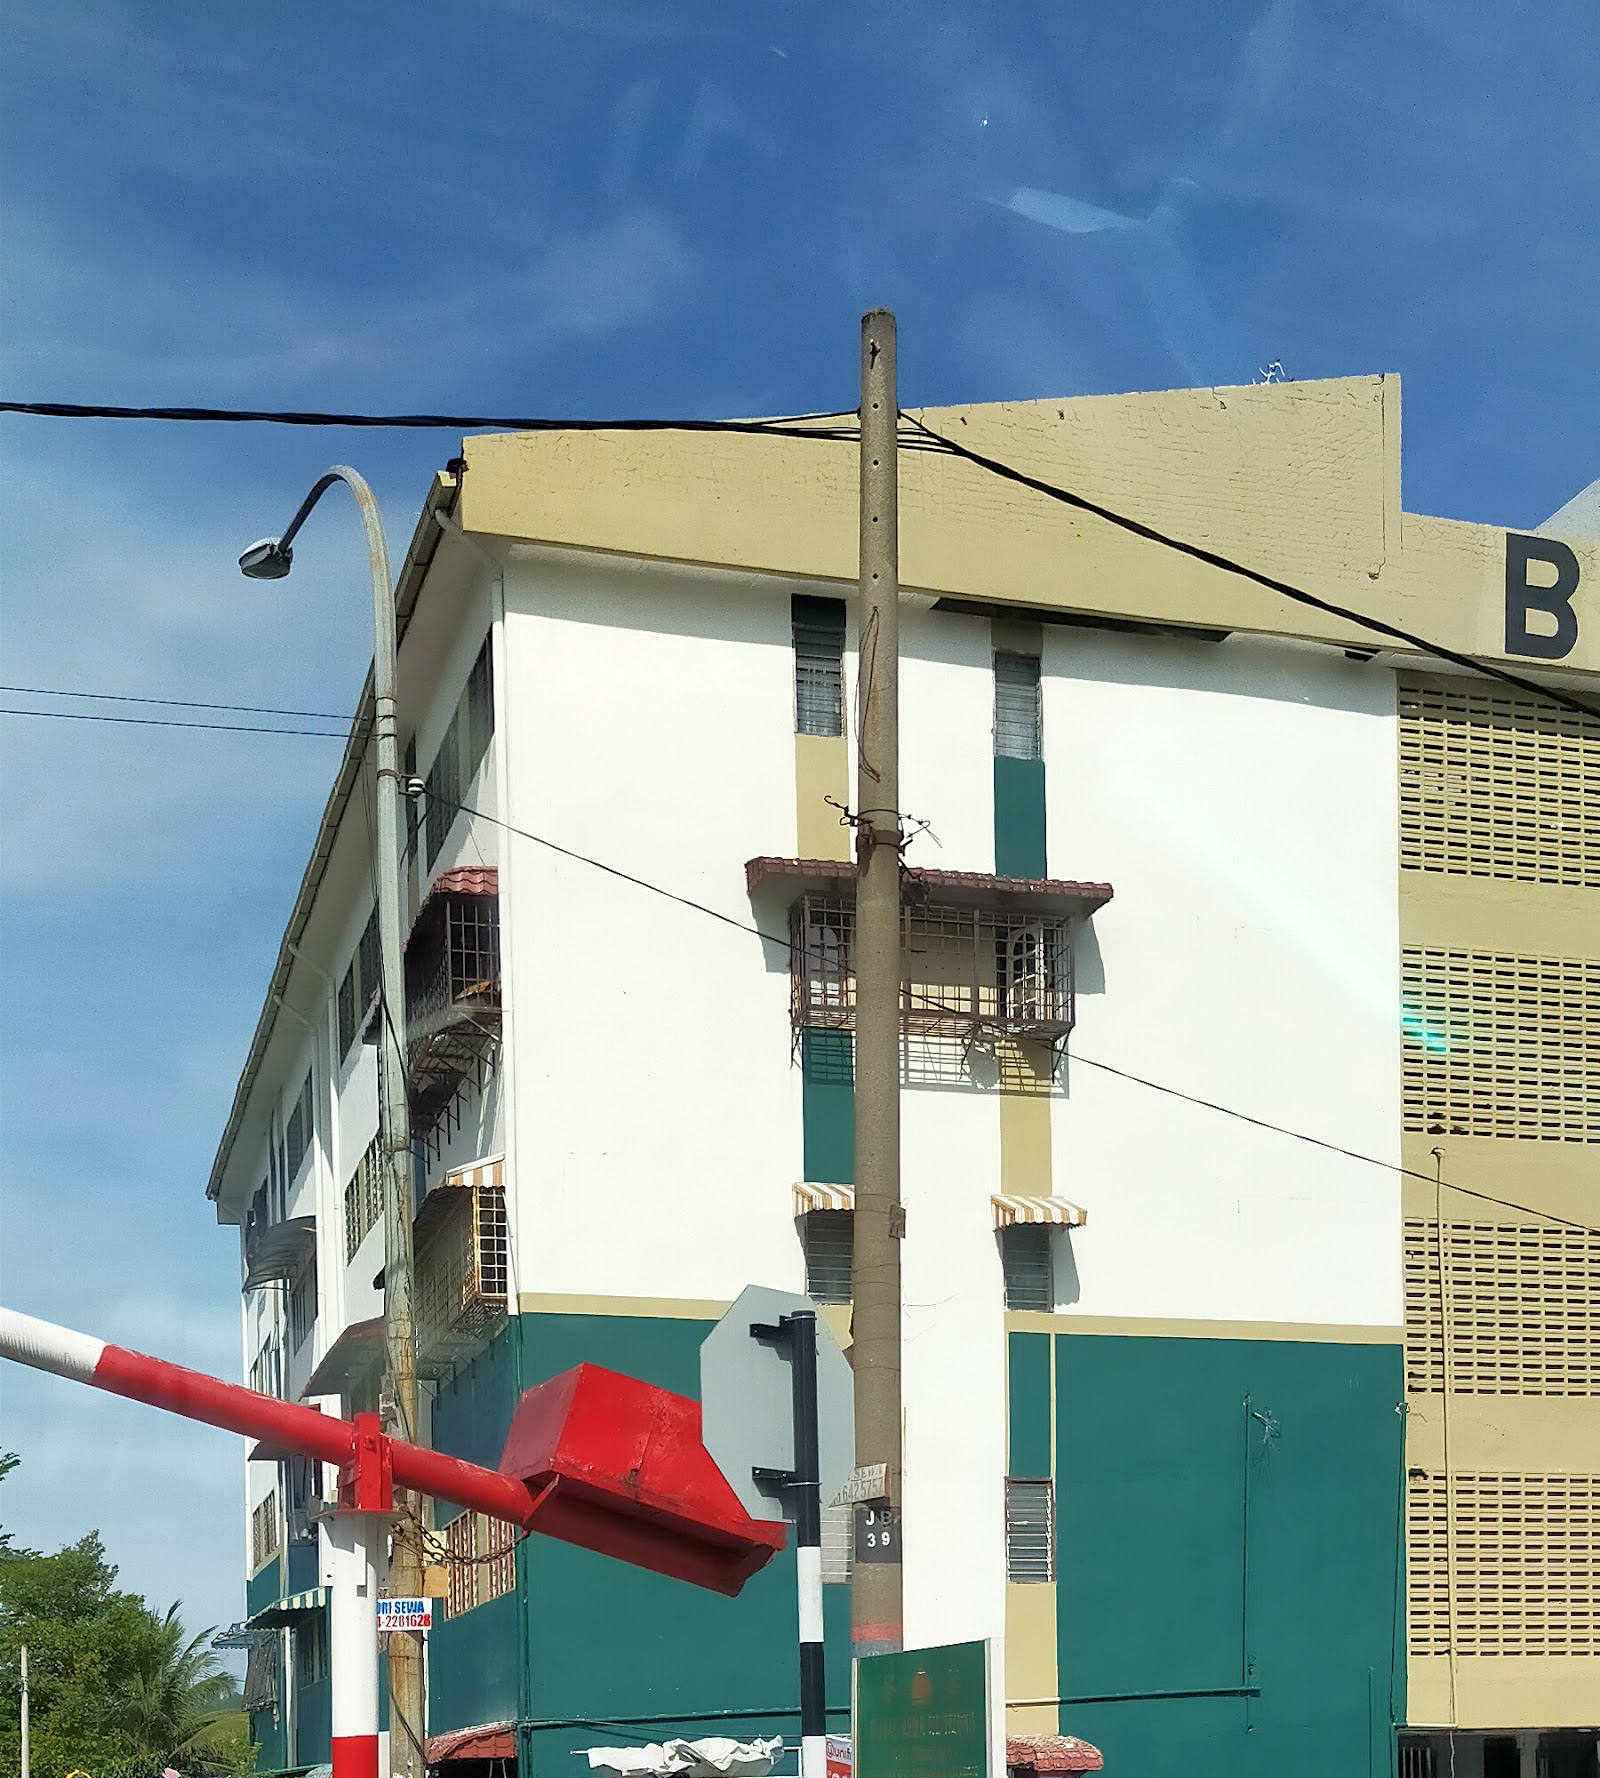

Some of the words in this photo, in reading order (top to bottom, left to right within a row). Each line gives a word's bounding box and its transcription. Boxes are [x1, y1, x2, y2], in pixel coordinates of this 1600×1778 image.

[1505, 532, 1580, 660] B
[867, 1531, 890, 1548] 39
[394, 1600, 425, 1614] SEWA
